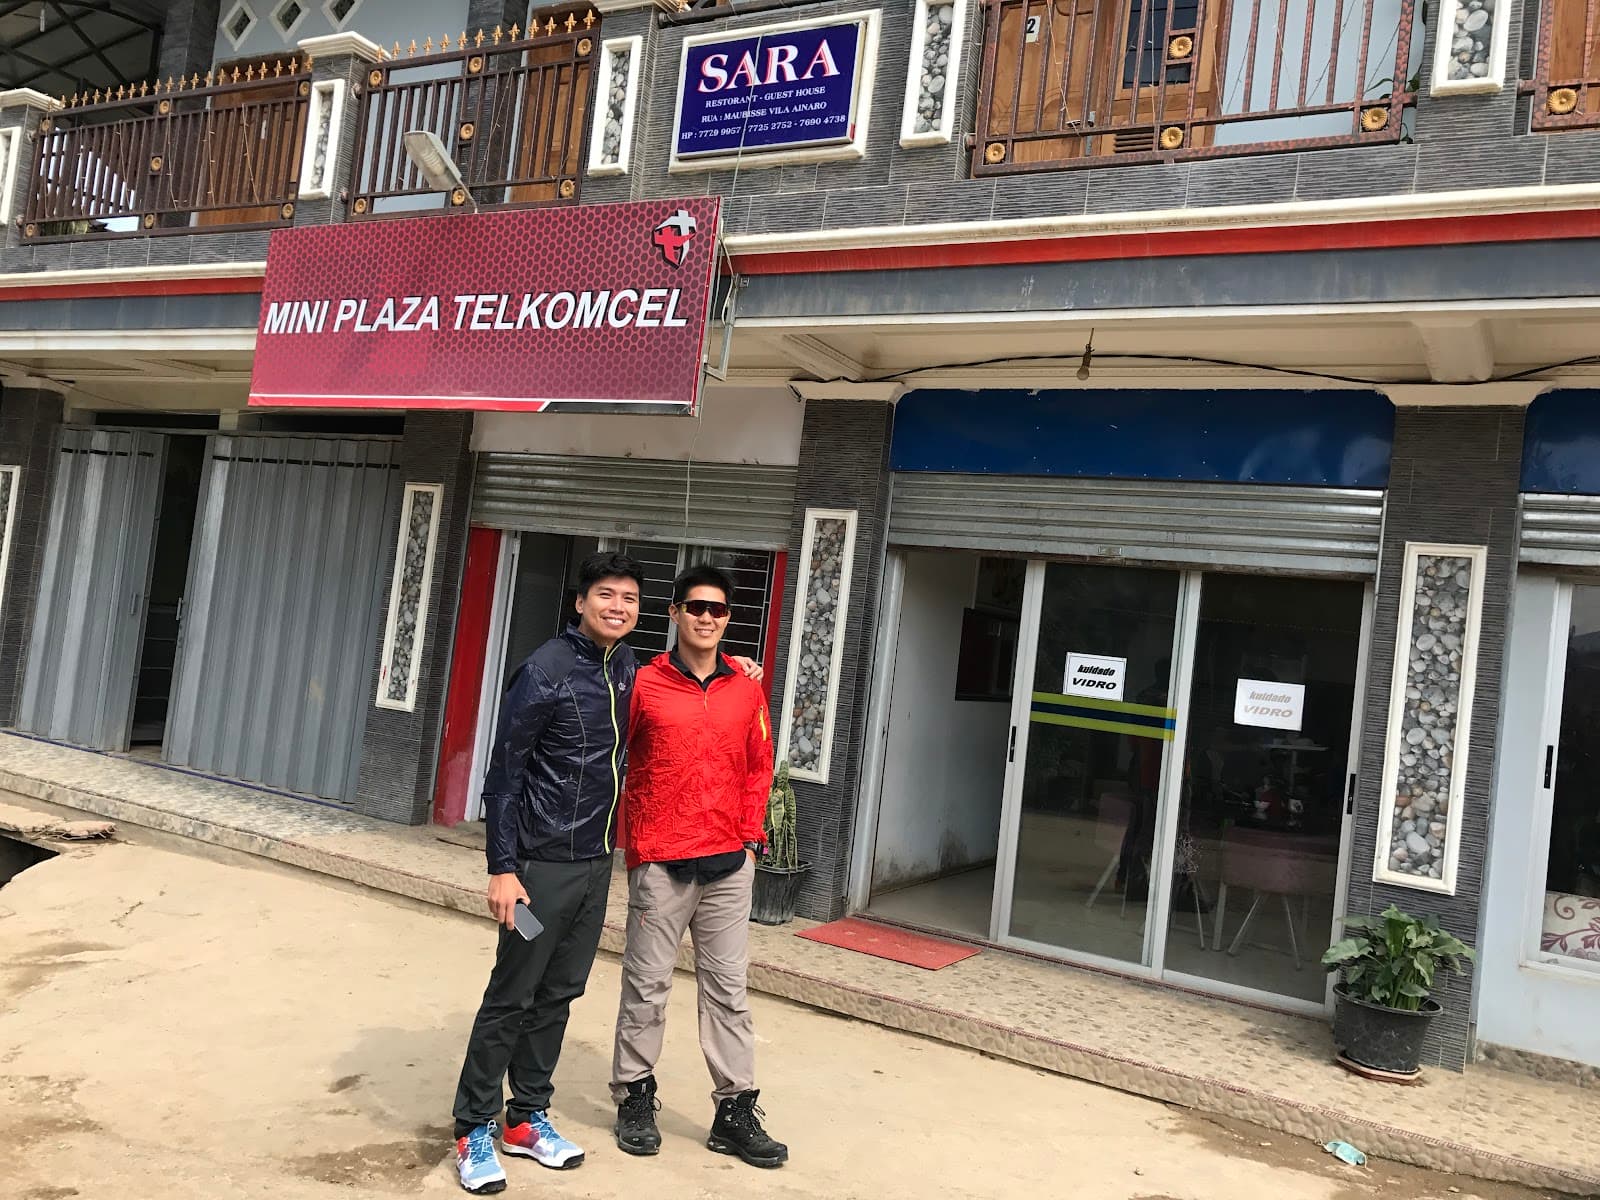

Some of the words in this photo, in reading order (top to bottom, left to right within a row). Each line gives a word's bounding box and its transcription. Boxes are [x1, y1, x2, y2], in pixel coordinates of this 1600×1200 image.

[1026, 18, 1036, 34] 2
[697, 38, 841, 93] SARA
[705, 94, 759, 108] RESTORANT
[764, 90, 794, 101] GUEST
[795, 86, 826, 97] HOUSE
[701, 114, 718, 123] RUA
[723, 108, 768, 121] MAUBISSE
[769, 104, 790, 115] VILA
[792, 101, 827, 113] AINARO
[681, 131, 694, 140] HP
[747, 123, 769, 133] 7725
[799, 117, 821, 127] 7690
[823, 114, 846, 124] 4738
[263, 300, 329, 335] MINI
[333, 296, 440, 333] PLAZA
[453, 288, 689, 331] TELKOMCEL
[1077, 664, 1116, 677] kuidado
[1072, 677, 1117, 690] VIDRO
[1249, 690, 1292, 704] kuidado
[1243, 704, 1293, 718] VIDRO
